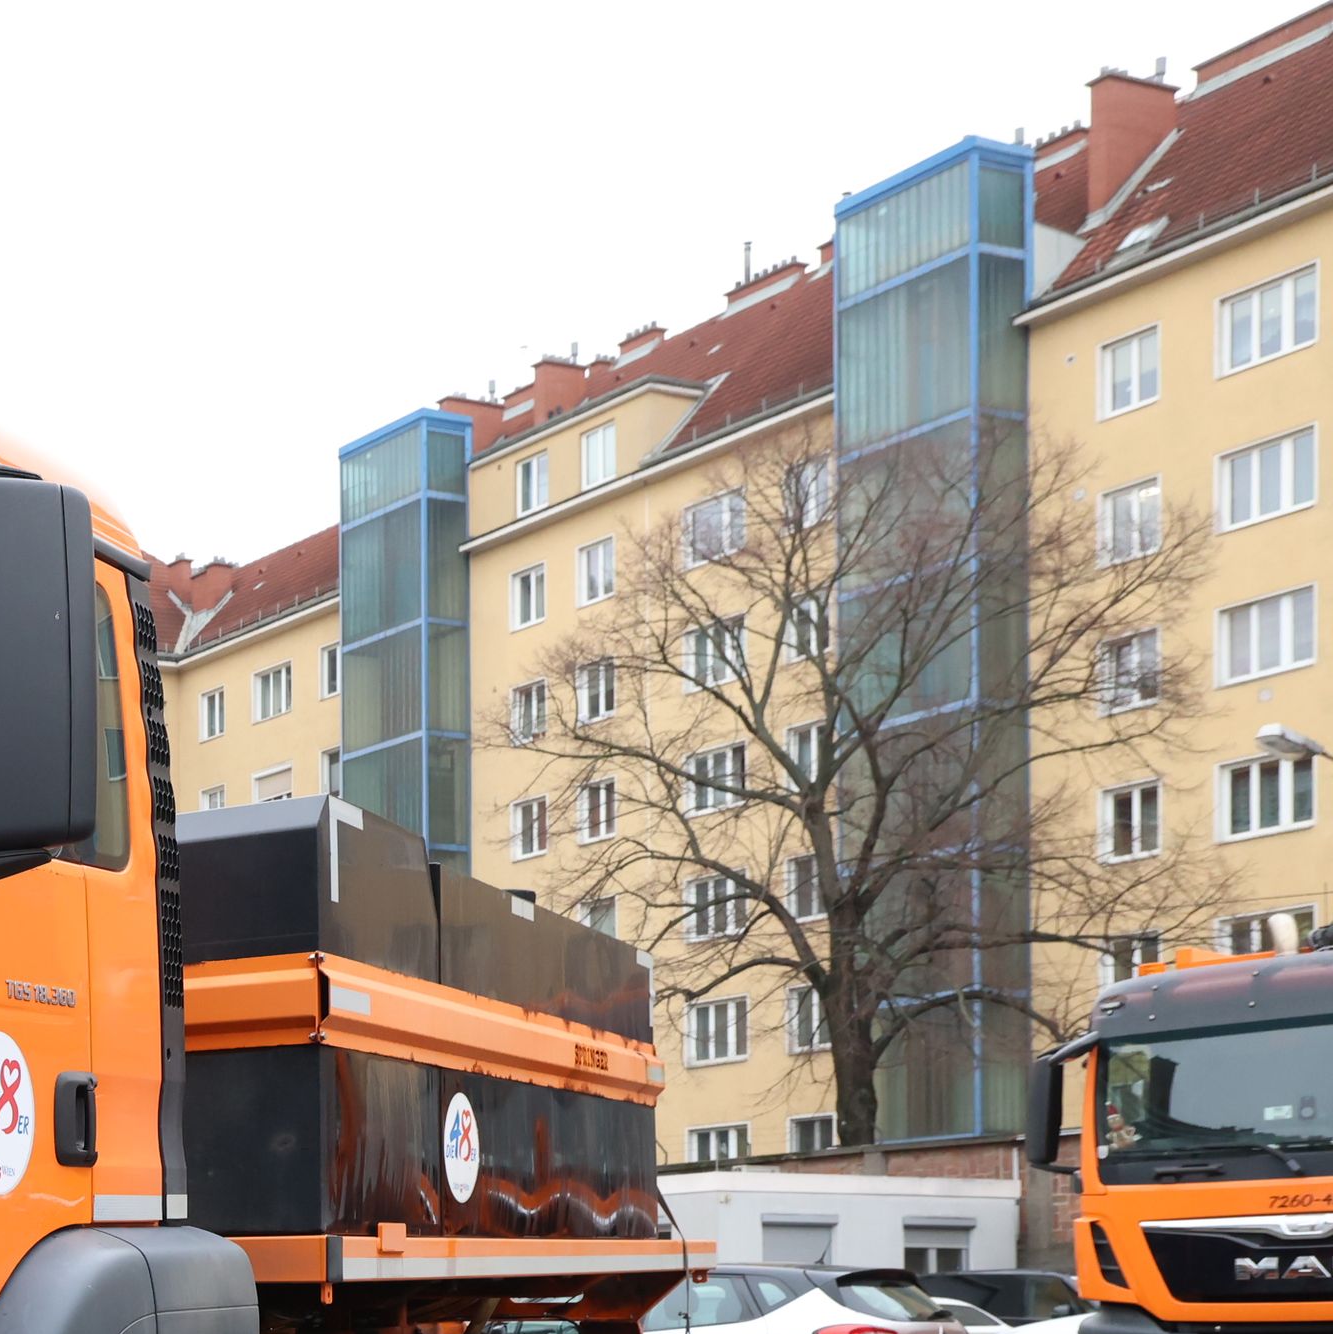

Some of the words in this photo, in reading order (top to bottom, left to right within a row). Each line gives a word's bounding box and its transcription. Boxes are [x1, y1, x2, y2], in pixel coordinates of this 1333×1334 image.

[5, 979, 31, 1001] TGS
[34, 984, 76, 1008] 18.360
[17, 1115, 30, 1136] ER
[449, 1109, 472, 1162] 48
[1269, 1194, 1333, 1209] 7260-4
[1234, 1255, 1333, 1280] MA
